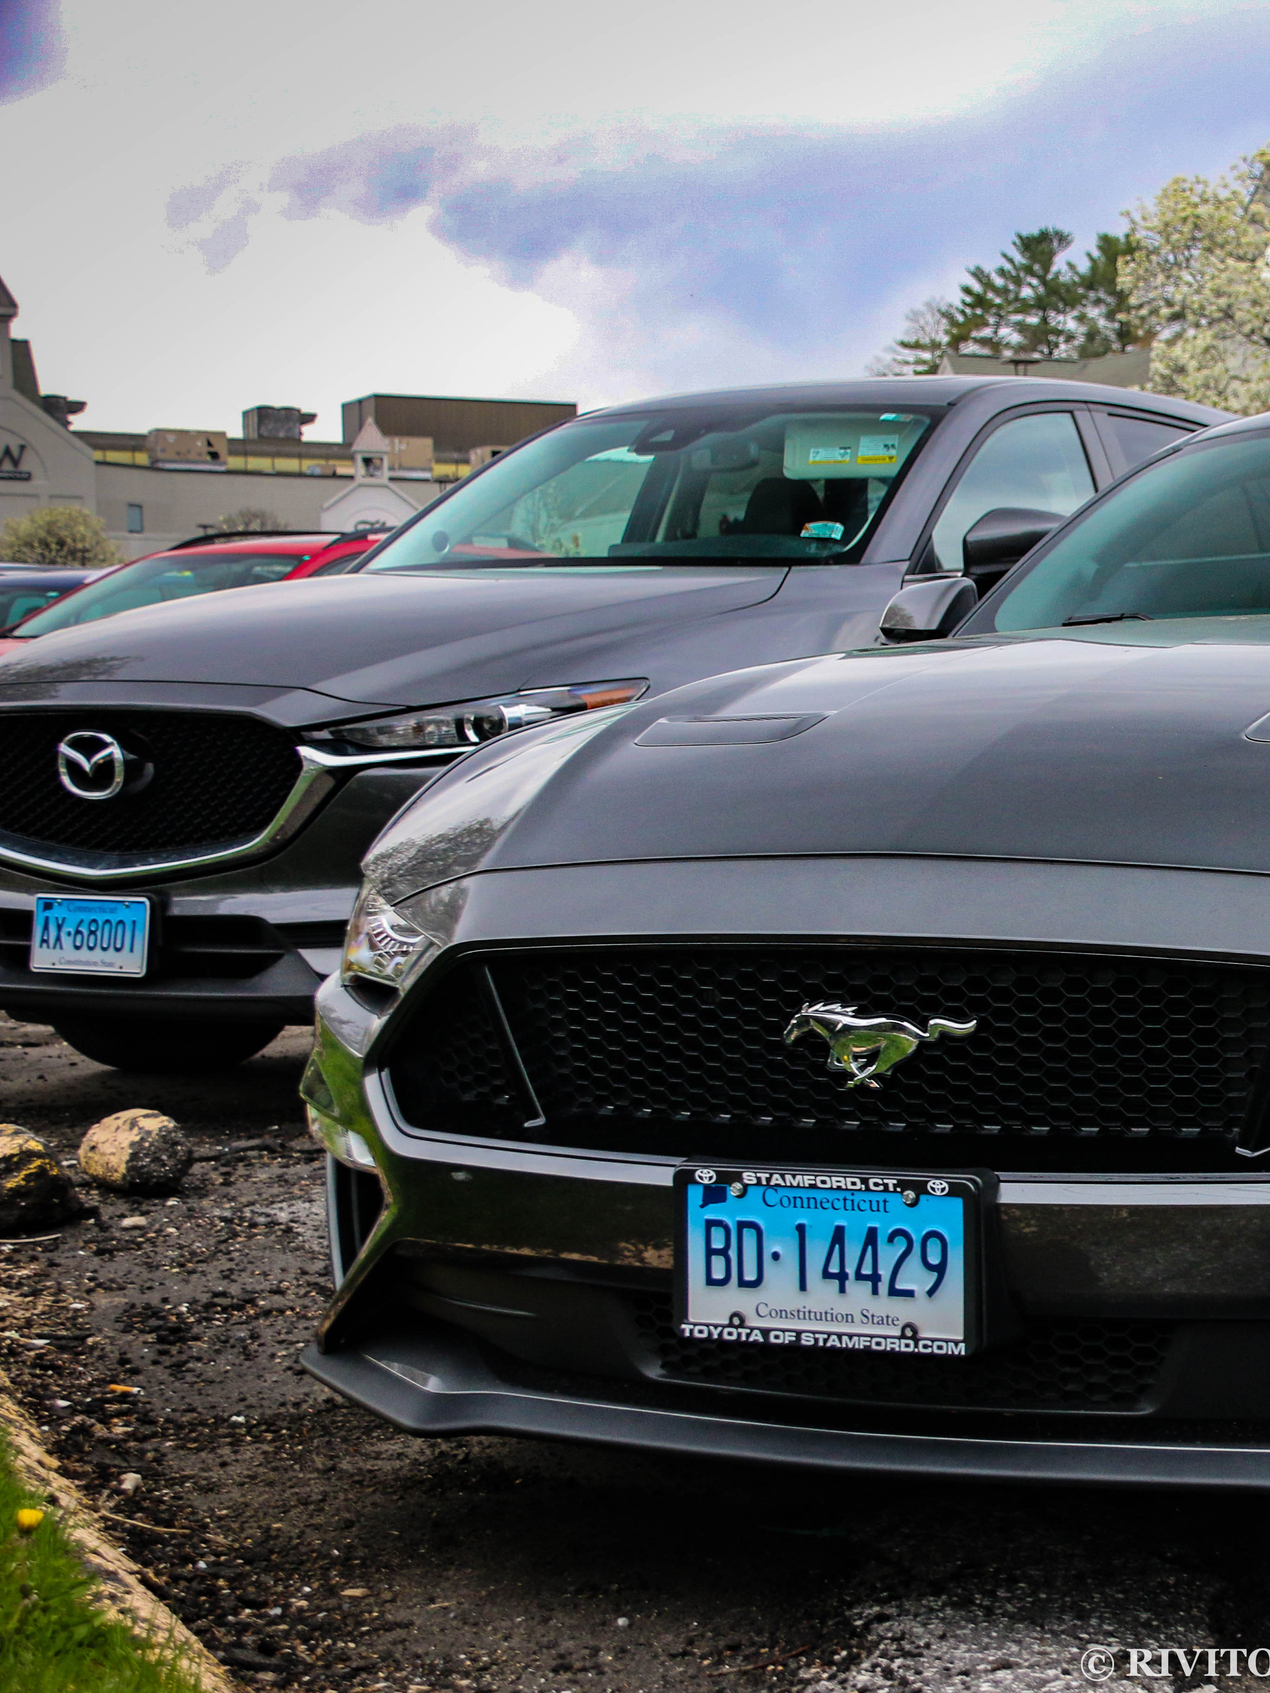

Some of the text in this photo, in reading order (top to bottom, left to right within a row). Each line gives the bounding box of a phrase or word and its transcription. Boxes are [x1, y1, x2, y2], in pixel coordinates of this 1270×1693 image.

[742, 1171, 902, 1193] STAMFORD, CT.
[761, 1187, 890, 1214] Connecticut
[755, 1301, 900, 1328] Constitution State
[680, 1323, 966, 1355] TOYOTA OF STAMFORD.COM
